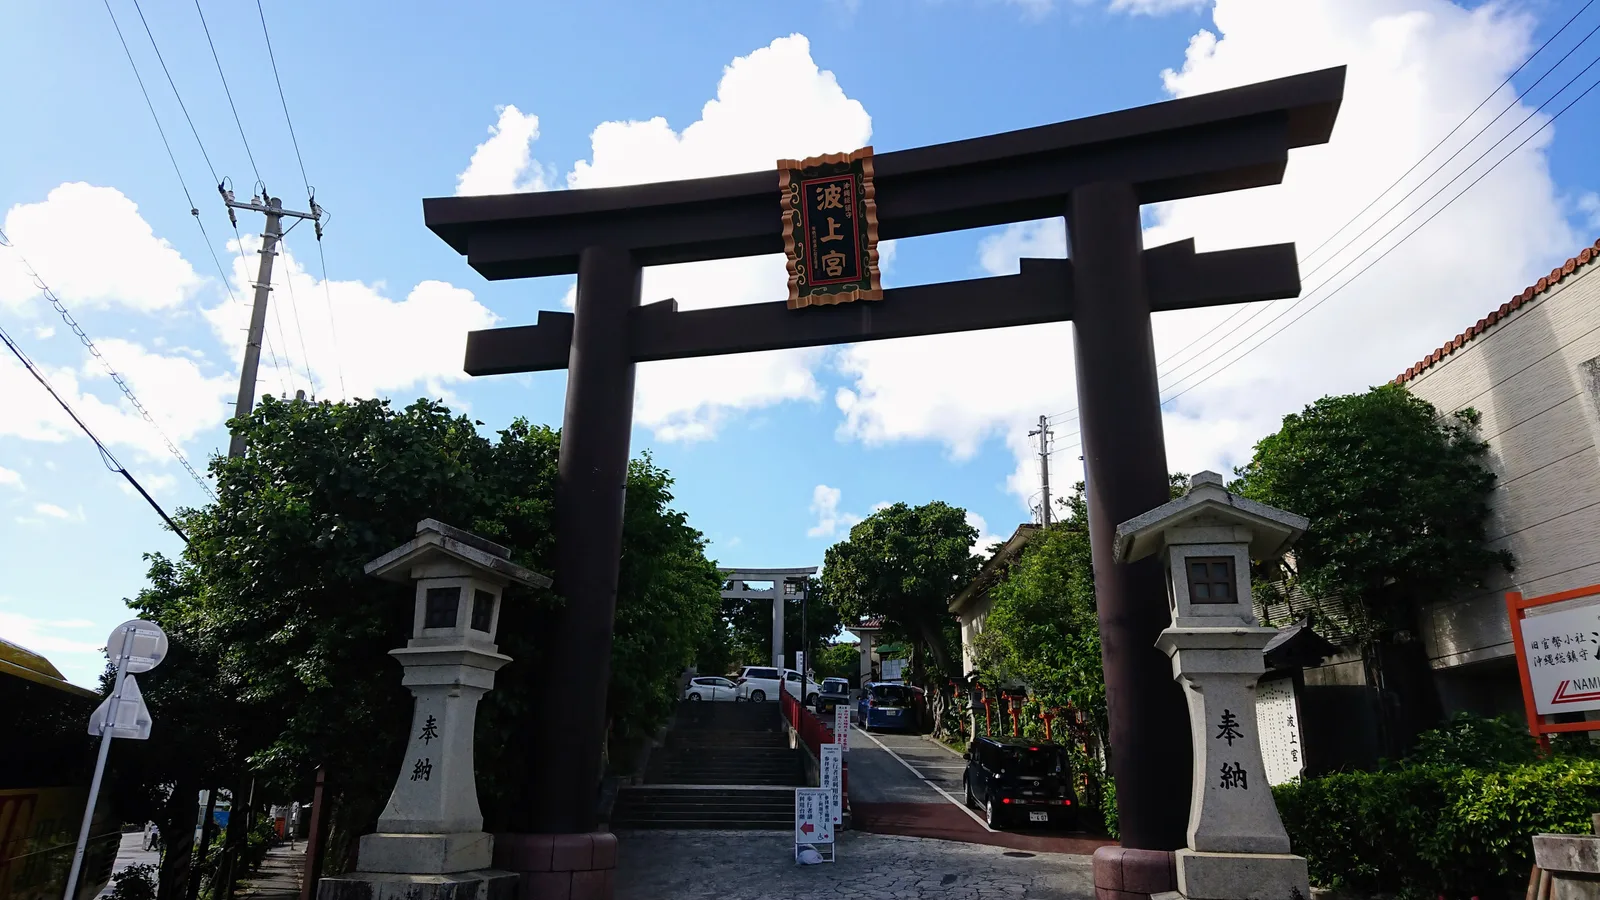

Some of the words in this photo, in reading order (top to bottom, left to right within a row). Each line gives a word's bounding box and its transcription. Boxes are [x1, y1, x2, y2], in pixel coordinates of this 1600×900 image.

[816, 183, 846, 277] 波上宮
[1531, 633, 1586, 650] 旧官幣小社
[1533, 648, 1588, 667] 沖縄総鎮守
[410, 715, 438, 781] 奉納
[1216, 709, 1248, 790] 奉納
[1287, 715, 1298, 762] 波上宮
